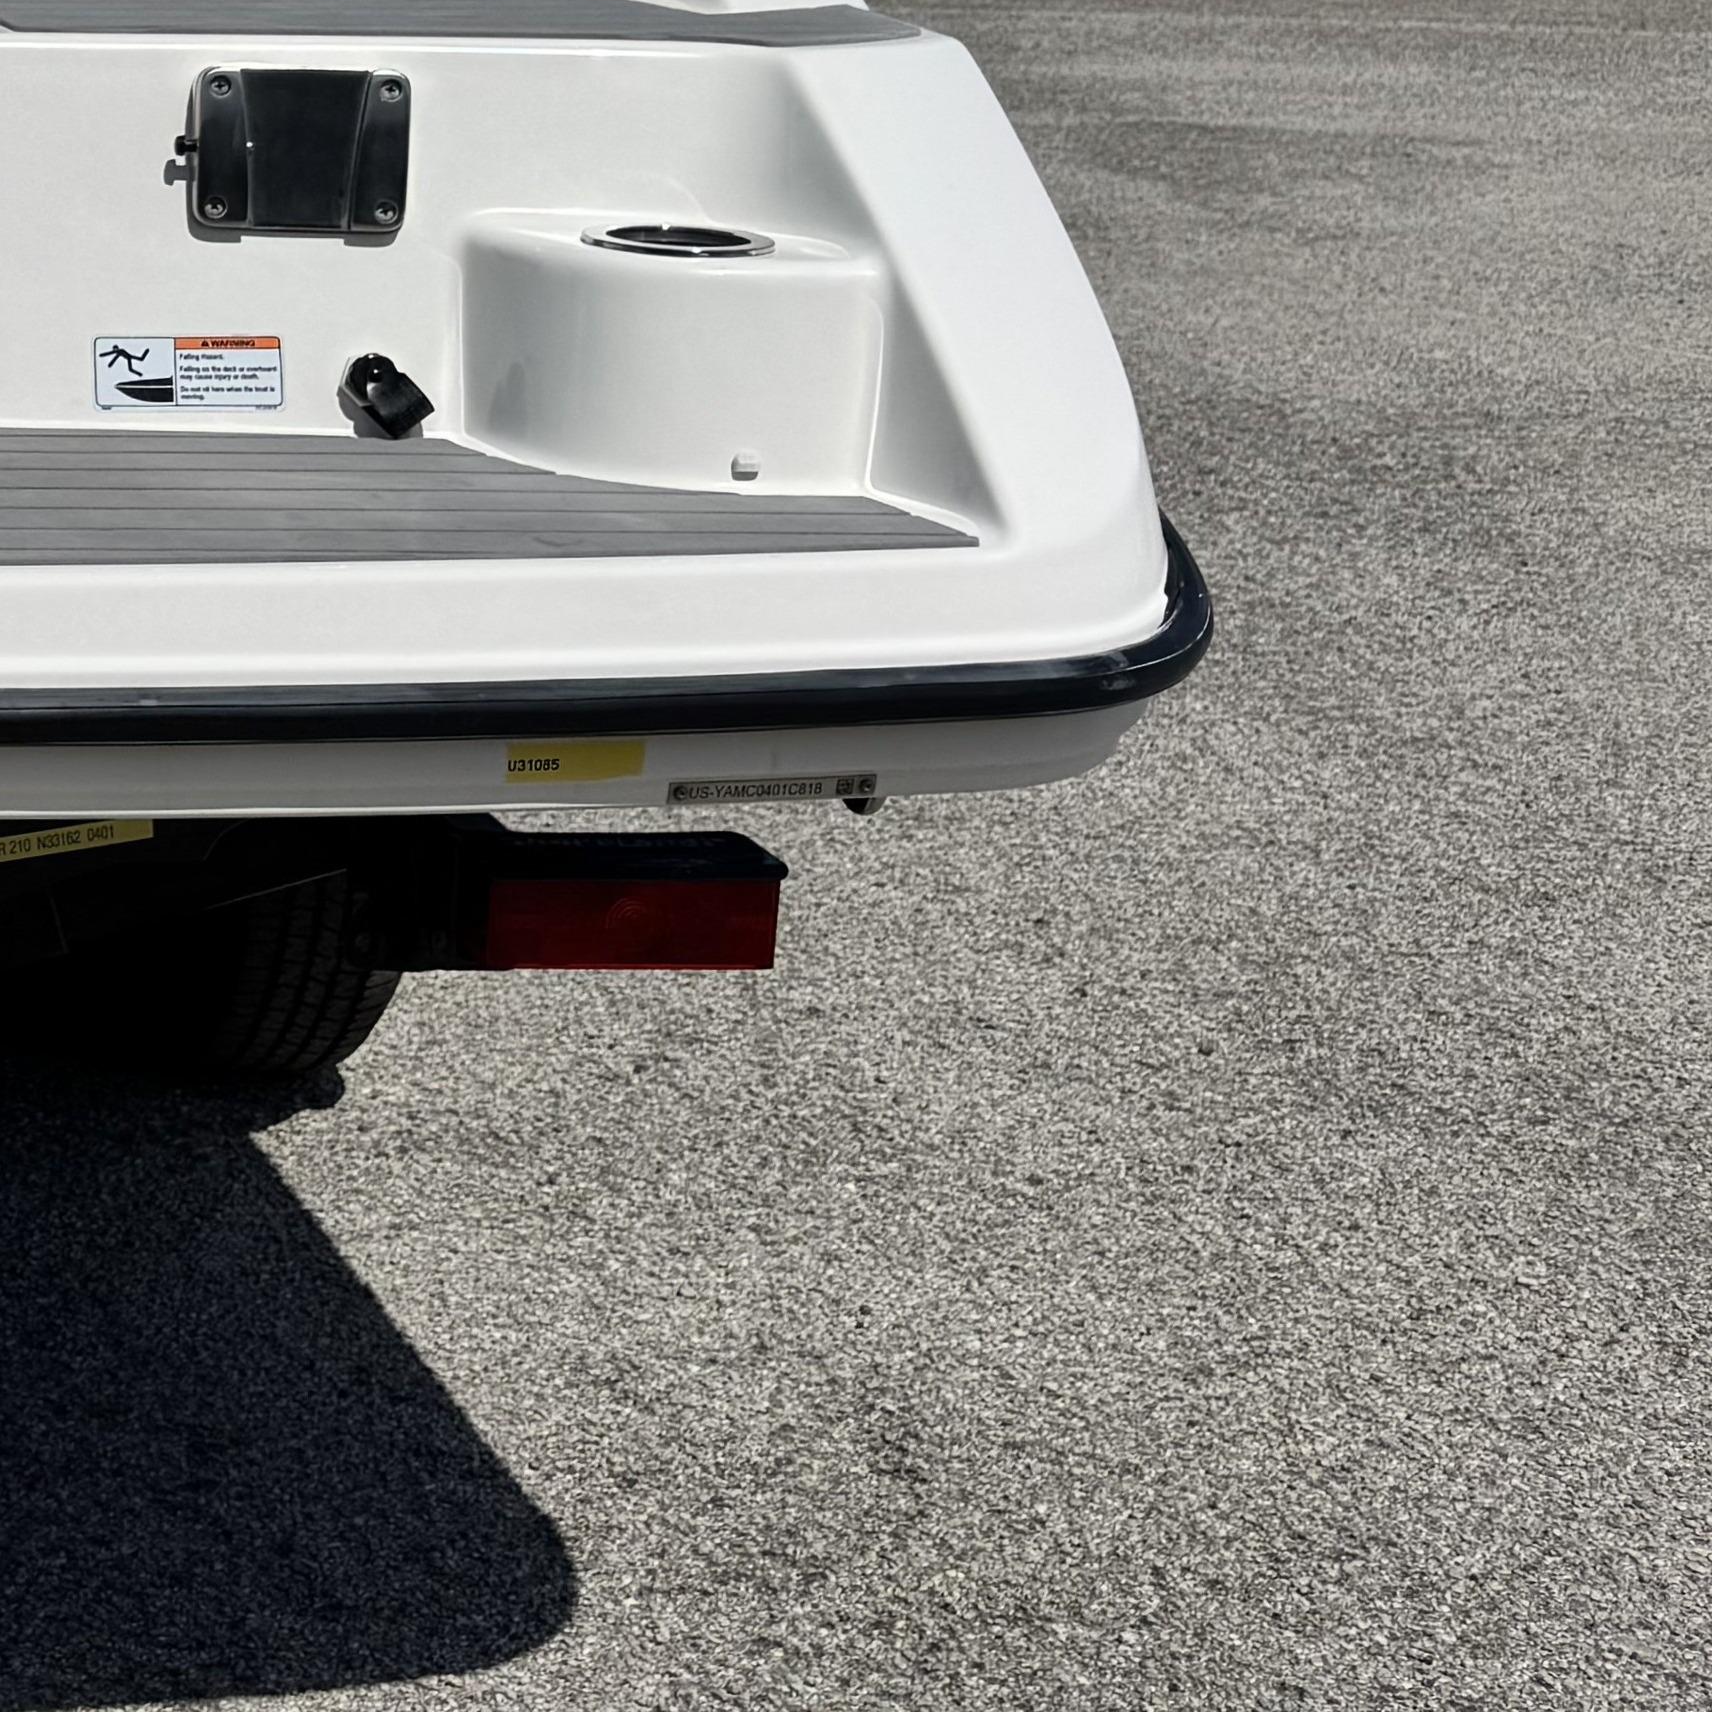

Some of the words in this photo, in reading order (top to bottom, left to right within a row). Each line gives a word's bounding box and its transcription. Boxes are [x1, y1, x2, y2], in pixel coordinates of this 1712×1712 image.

[179, 353, 199, 361] Falling
[507, 758, 560, 772] U31085
[689, 782, 823, 800] US-YAMC0401C818
[9, 838, 32, 855] 210
[87, 825, 114, 842] 0401
